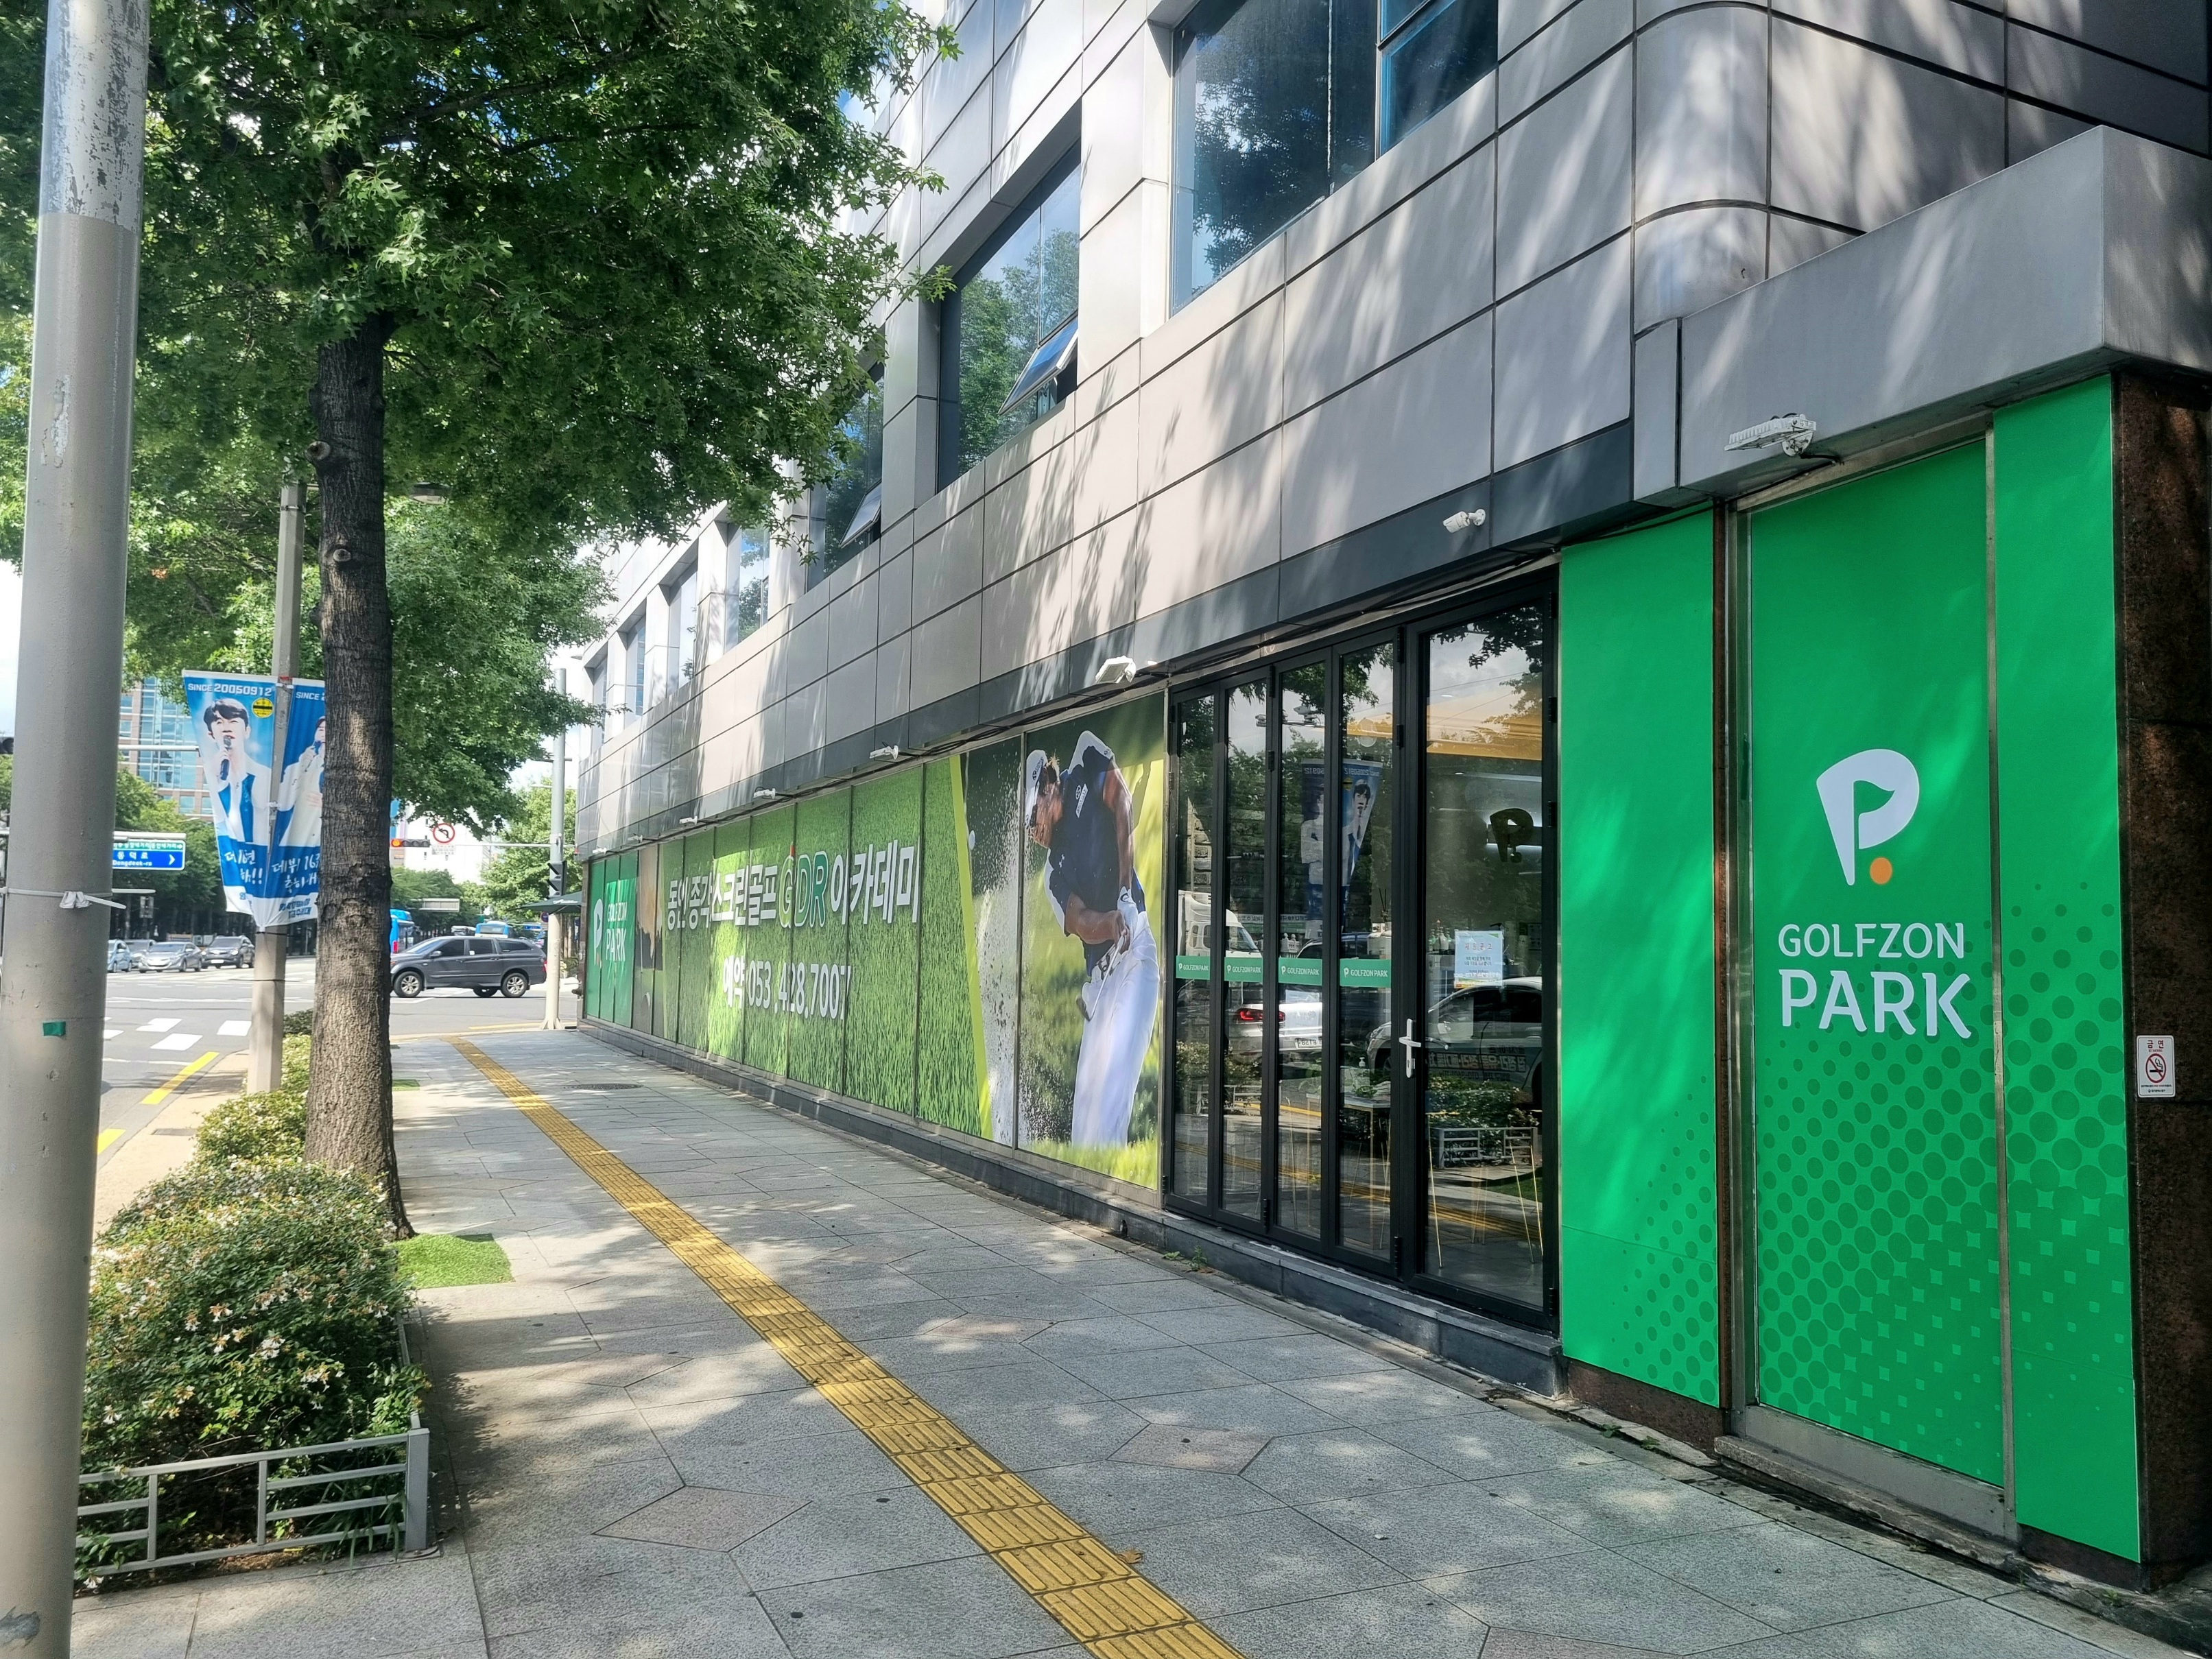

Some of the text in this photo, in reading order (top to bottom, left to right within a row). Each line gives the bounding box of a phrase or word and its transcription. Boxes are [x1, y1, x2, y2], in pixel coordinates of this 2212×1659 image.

[188, 683, 272, 697] SINCE 20050912
[296, 691, 320, 700] SINCE
[605, 928, 627, 962] PARK
[1778, 922, 1964, 959] GOLFZON
[1779, 969, 1972, 1039] PARK
[2147, 1040, 2164, 1049] 금연
